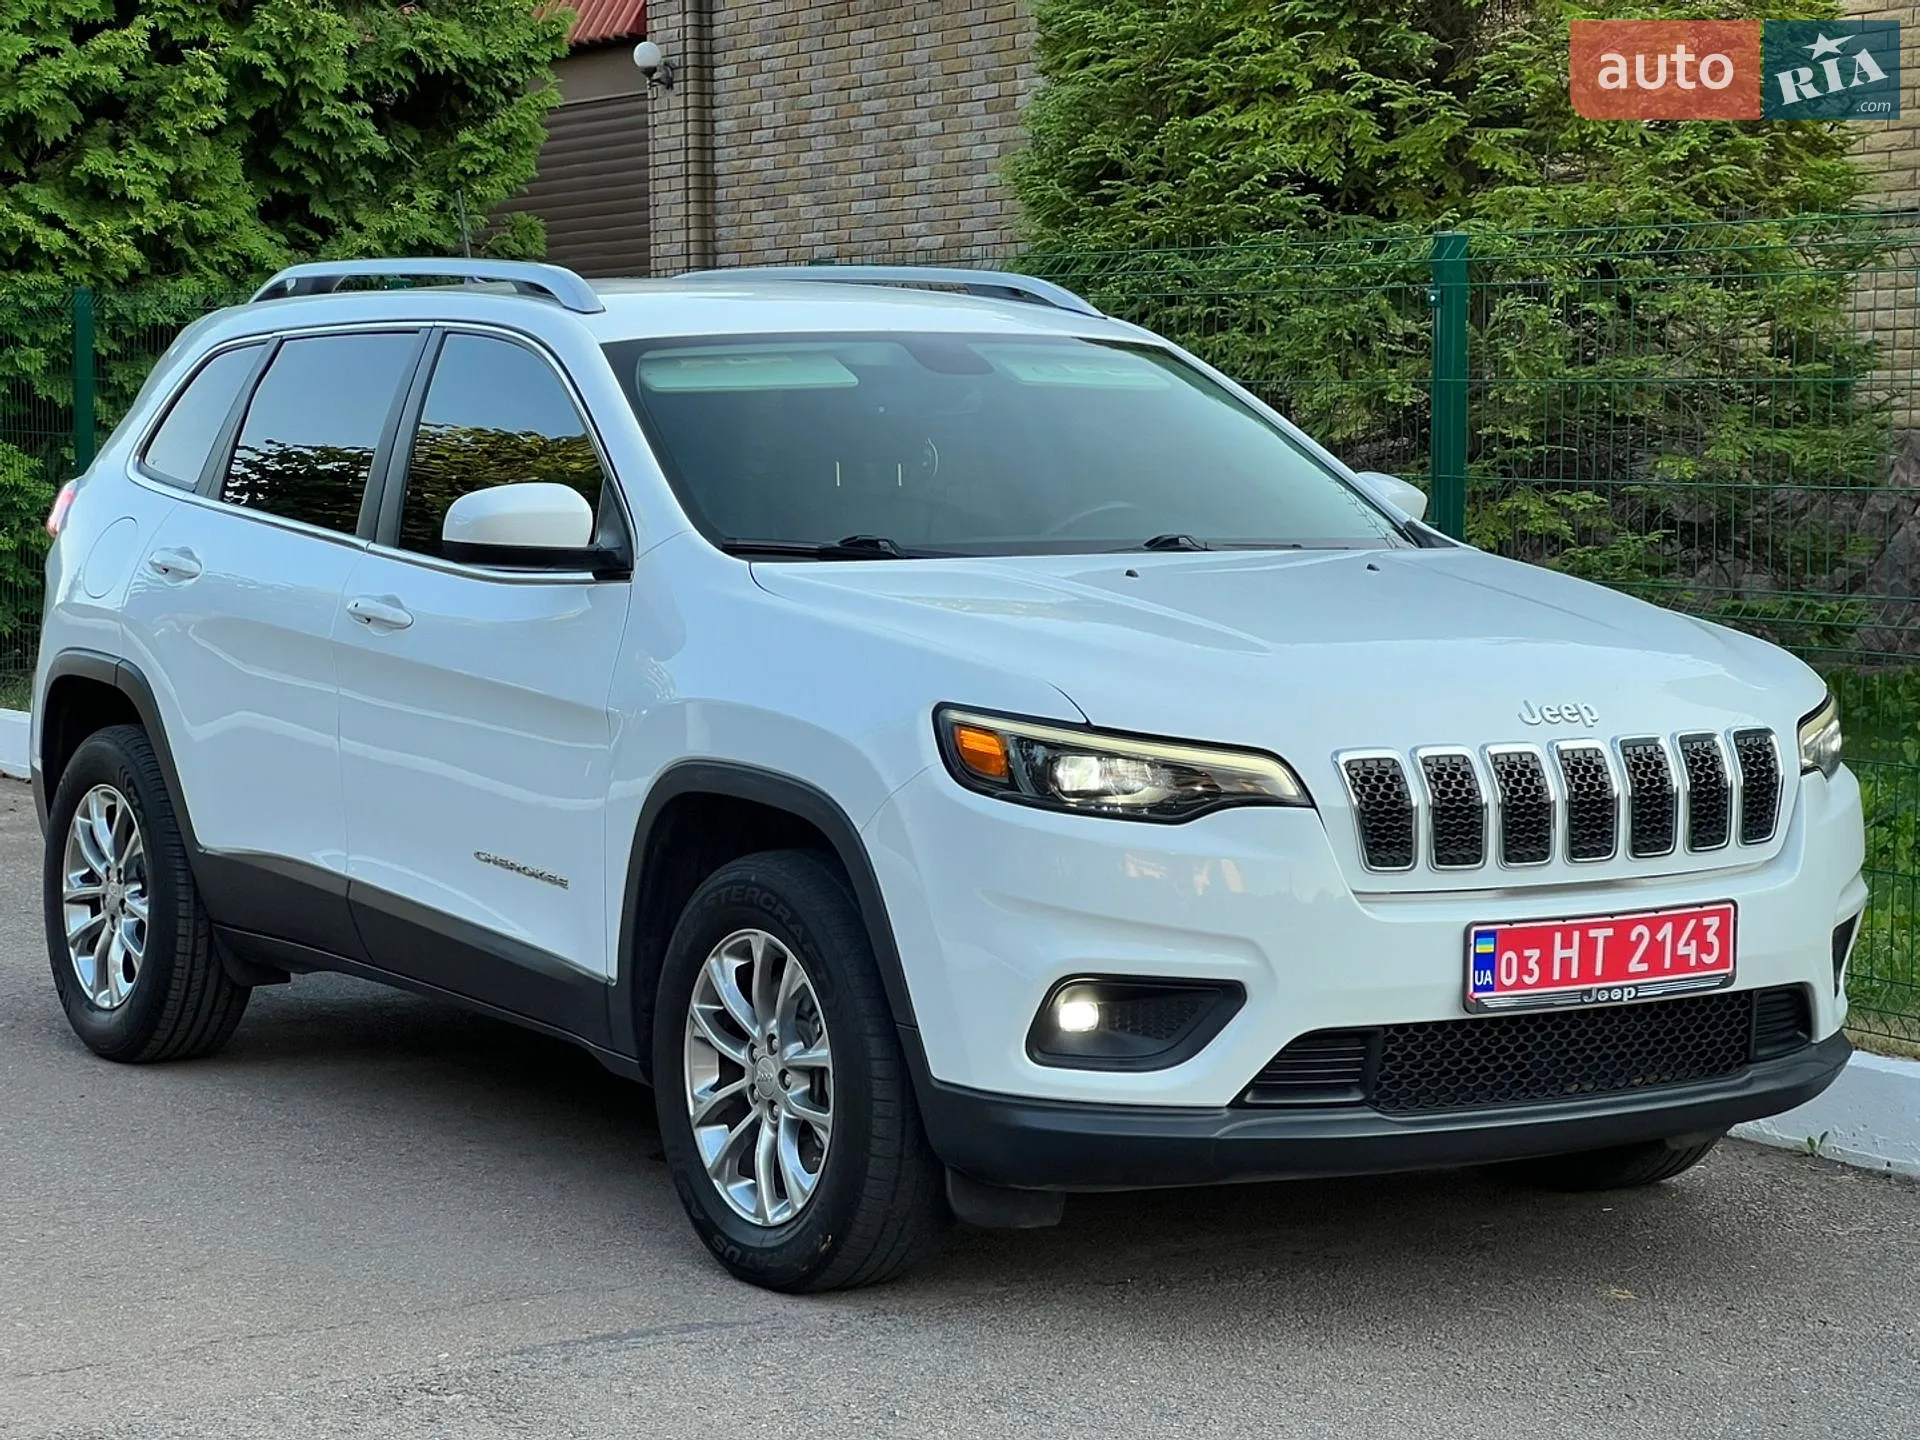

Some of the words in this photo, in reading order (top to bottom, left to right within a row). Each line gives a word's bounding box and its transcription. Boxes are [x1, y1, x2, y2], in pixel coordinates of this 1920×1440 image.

[1518, 699, 1600, 728] Jeep
[1500, 948, 1541, 986] 03
[1551, 927, 1614, 980] HT
[1627, 916, 1721, 974] 2143
[1474, 970, 1493, 985] UA
[1582, 985, 1636, 1003] Jeep
